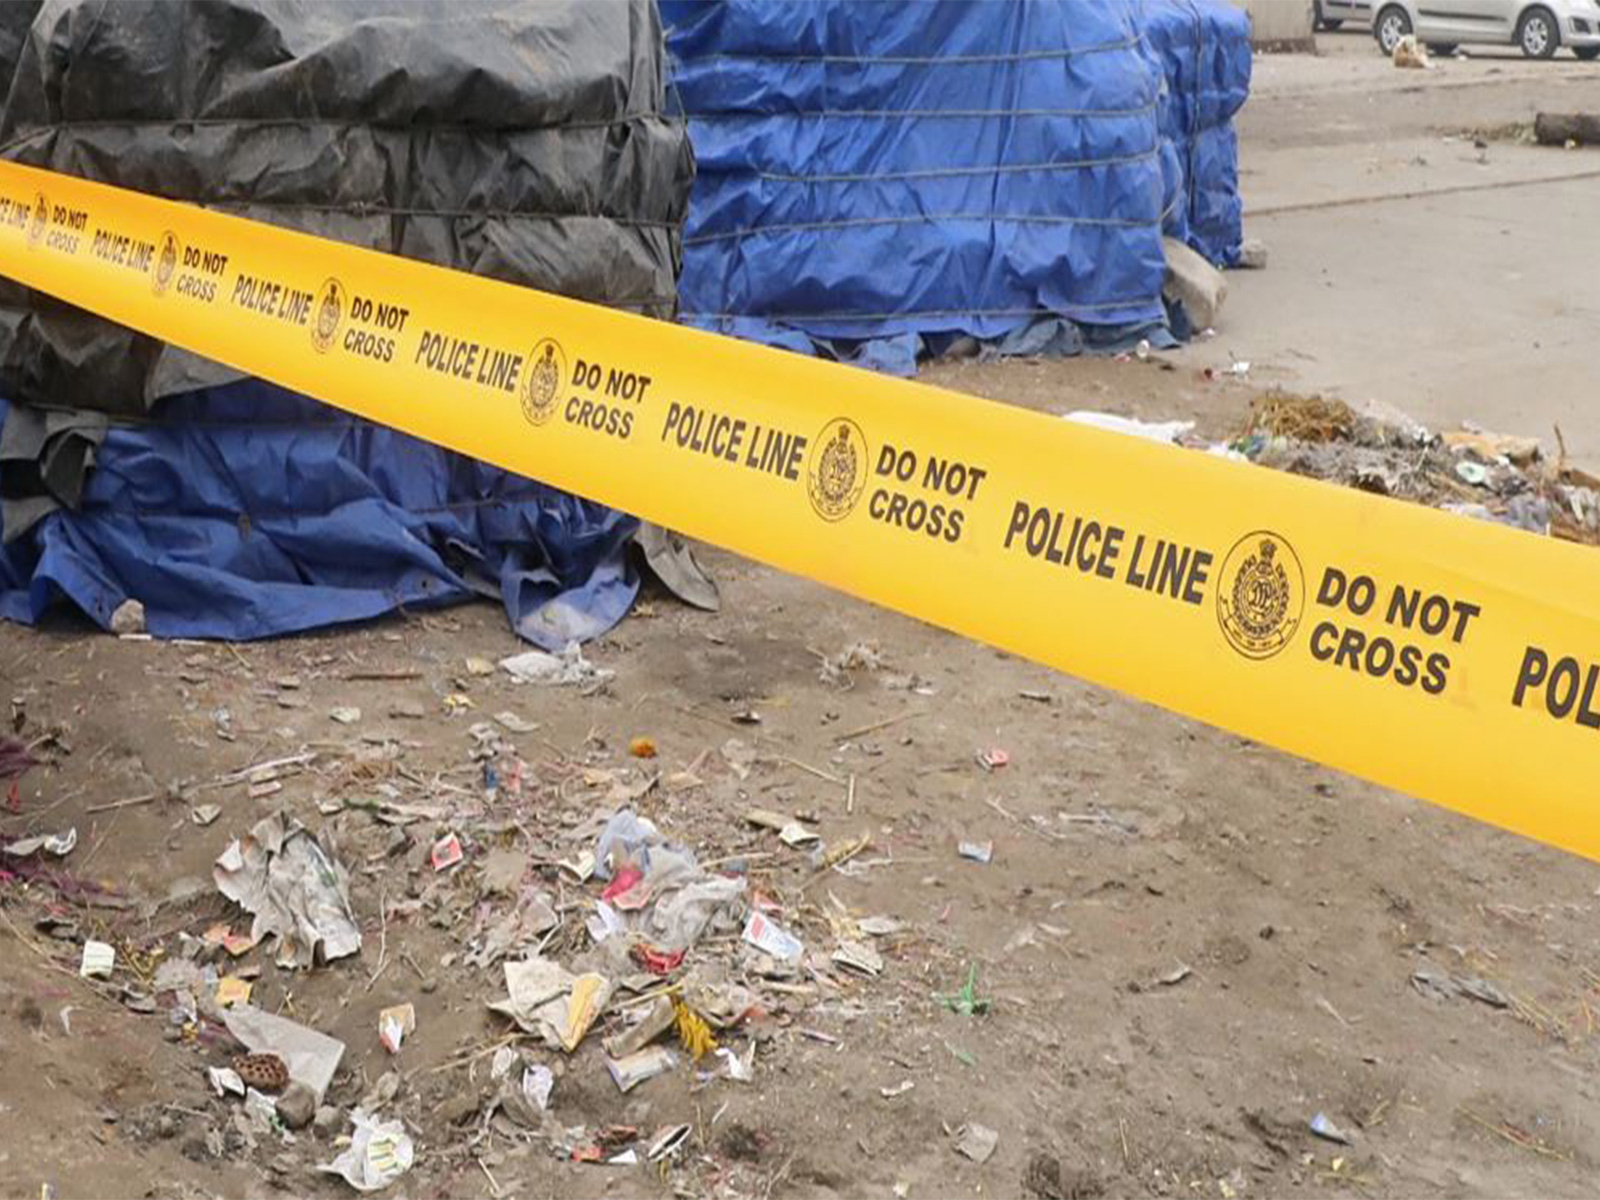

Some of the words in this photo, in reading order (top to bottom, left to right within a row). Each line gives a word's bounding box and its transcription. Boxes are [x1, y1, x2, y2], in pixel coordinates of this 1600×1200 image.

[46, 230, 80, 254] CROSS
[53, 204, 67, 225] DO
[67, 208, 88, 232] NOT
[90, 229, 130, 263] POLICE
[126, 240, 155, 273] LINE
[183, 245, 201, 268] DO
[201, 250, 228, 276] NOT
[176, 274, 217, 303] CROSS
[231, 273, 281, 316] POLICE
[277, 287, 314, 326] LINE
[350, 296, 373, 323] DO
[375, 303, 409, 333] NOT
[343, 328, 395, 363] CROSS
[415, 330, 480, 380] POLICE
[476, 347, 523, 392] LINE
[571, 359, 603, 391] DO
[605, 368, 651, 403] NOT
[565, 397, 634, 440] CROSS
[662, 402, 748, 463] POLICE
[744, 425, 808, 482] LINE
[875, 444, 918, 482] DO
[922, 456, 988, 500] NOT
[869, 488, 965, 543] CROSS
[1004, 500, 1126, 579] POLICE
[1125, 533, 1214, 606] LINE
[1316, 566, 1378, 617] DO
[1385, 584, 1482, 644] NOT
[1310, 620, 1451, 696] CROSS
[1511, 645, 1600, 731] POL
